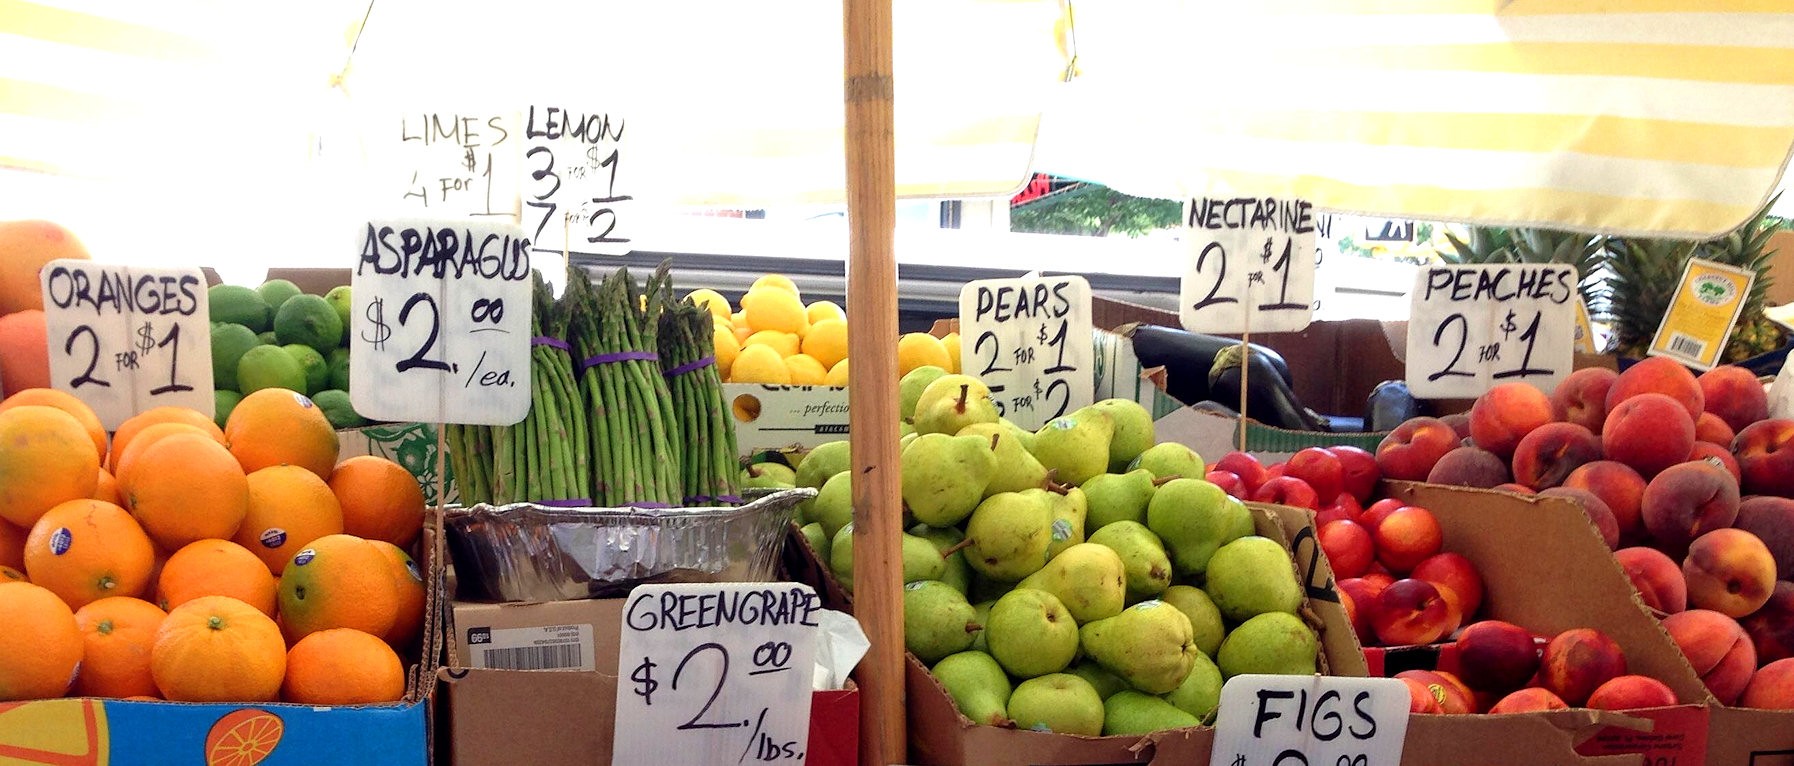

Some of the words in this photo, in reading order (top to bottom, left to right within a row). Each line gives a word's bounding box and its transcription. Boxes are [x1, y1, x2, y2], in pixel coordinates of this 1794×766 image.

[401, 113, 508, 146] LIMES
[526, 105, 625, 144] LEMON
[526, 146, 561, 200] 3
[1188, 196, 1314, 234] NECTARINE
[357, 221, 531, 281] ASPARAGUS
[48, 266, 200, 316] ORANGES
[1193, 241, 1239, 311] 2
[1425, 267, 1572, 305] PEACHES
[975, 281, 1070, 323] PEARS
[65, 324, 111, 389] 2
[115, 351, 140, 371] FOR
[974, 330, 1013, 377] 2
[1013, 347, 1035, 366] FOR
[1427, 313, 1476, 382] 2
[1478, 342, 1500, 364] FOR
[803, 400, 849, 417] perfectio
[1012, 395, 1034, 412] FOR
[626, 588, 822, 632] GREENGRAPE
[1253, 689, 1378, 742] FIGS
